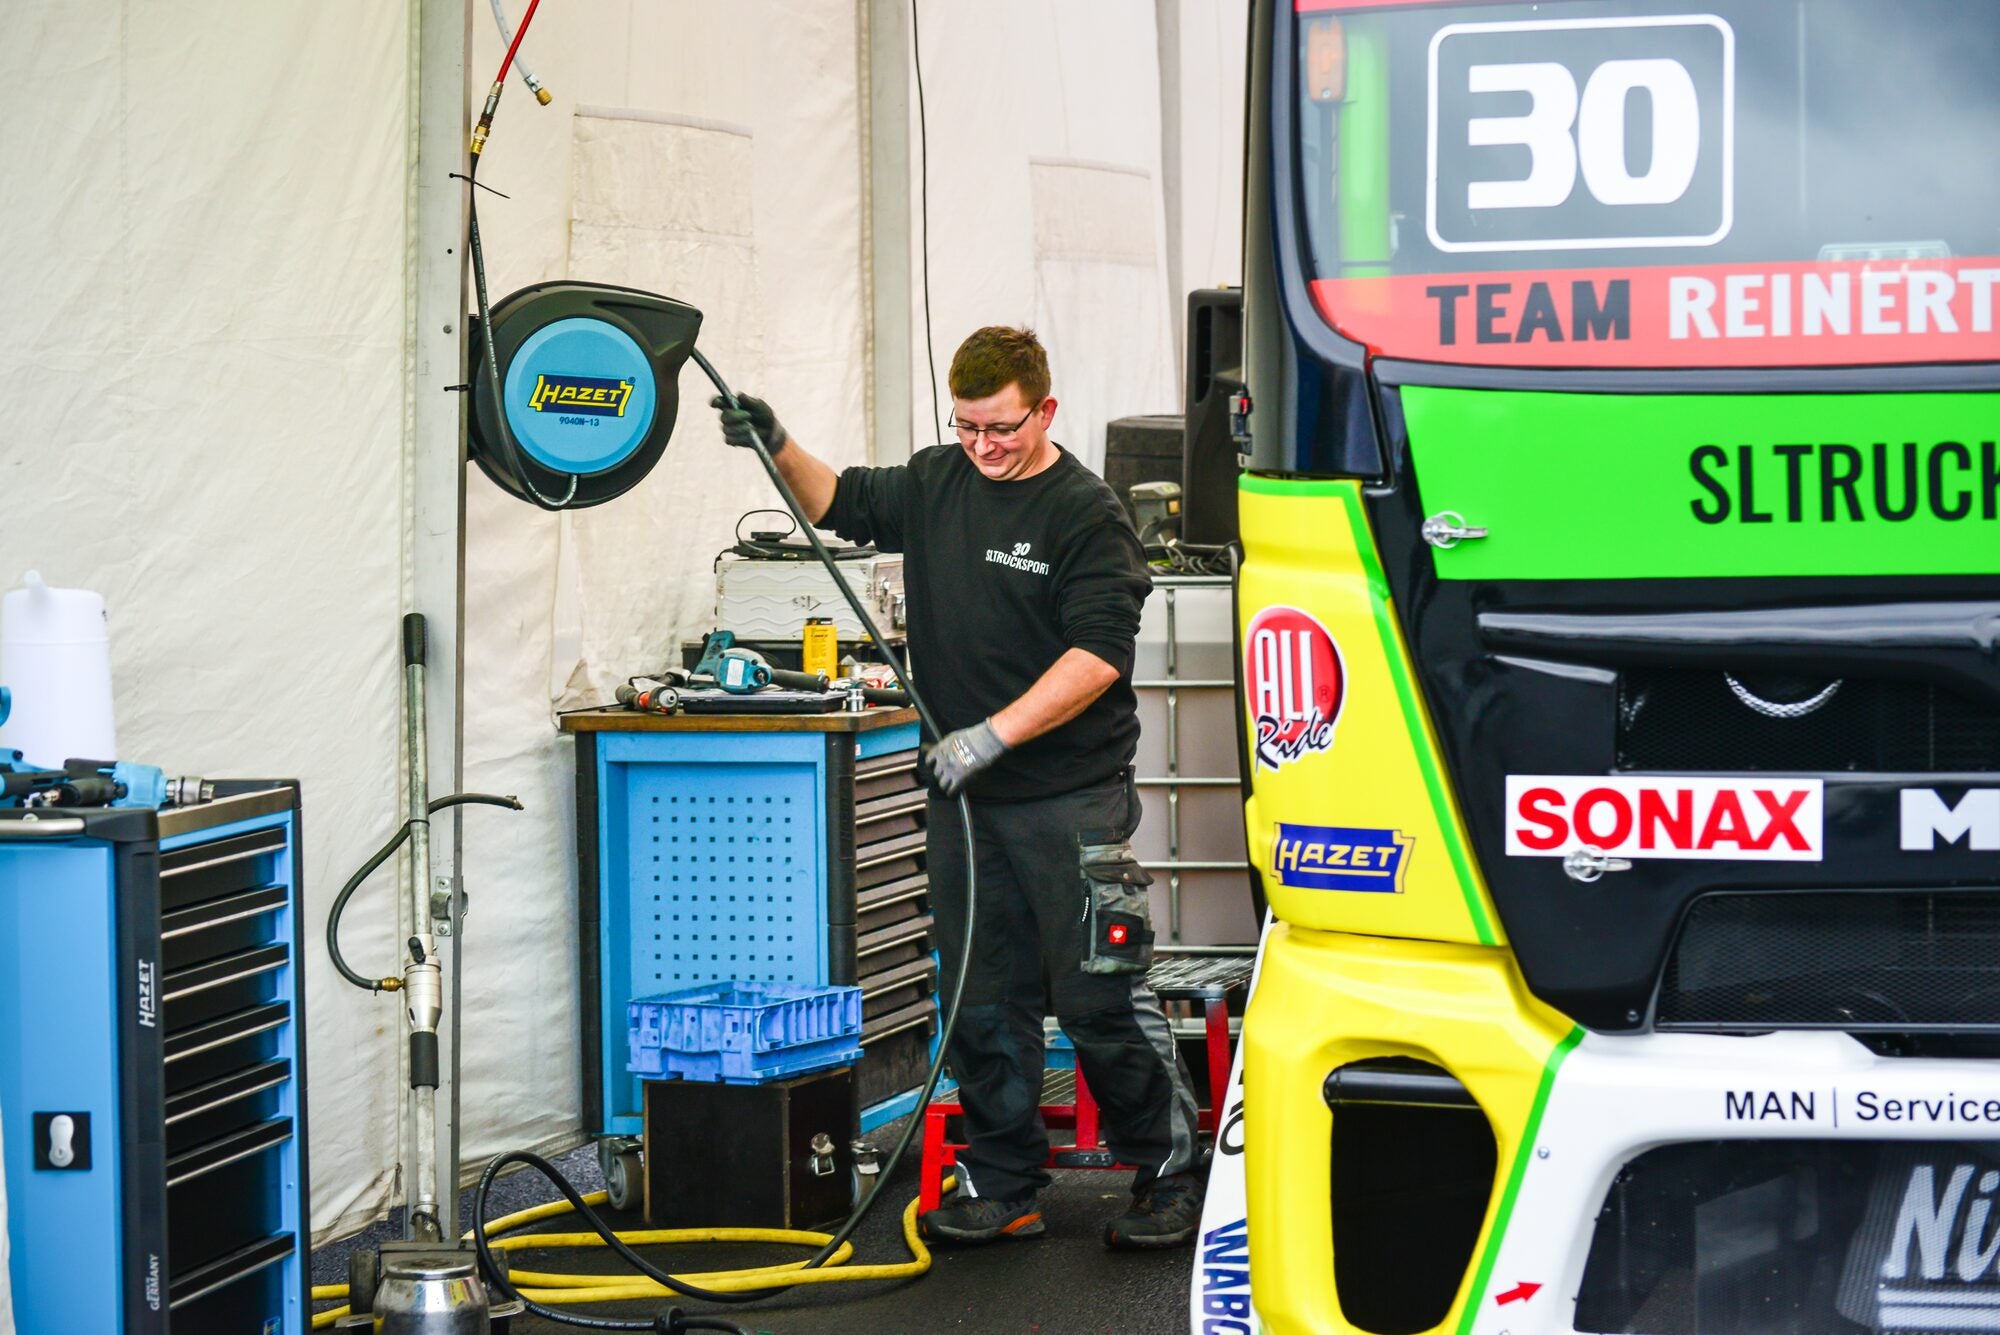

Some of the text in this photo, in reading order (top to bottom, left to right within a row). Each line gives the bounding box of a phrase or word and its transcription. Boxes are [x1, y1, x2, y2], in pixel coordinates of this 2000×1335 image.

[1467, 57, 1700, 209] 30
[1426, 267, 2000, 346] TEAM REINERT
[540, 384, 622, 404] HAZET
[985, 548, 1050, 576] SLTRUCKSPORT
[1011, 542, 1032, 557] 30
[1254, 628, 1324, 722] ALL
[1254, 708, 1334, 774] Ride
[1515, 786, 1813, 851] SONAX
[1278, 839, 1398, 871] HAZET
[138, 959, 156, 1028] HAZET
[1725, 1090, 2000, 1122] MAN Service
[149, 1253, 160, 1311] GERMANY
